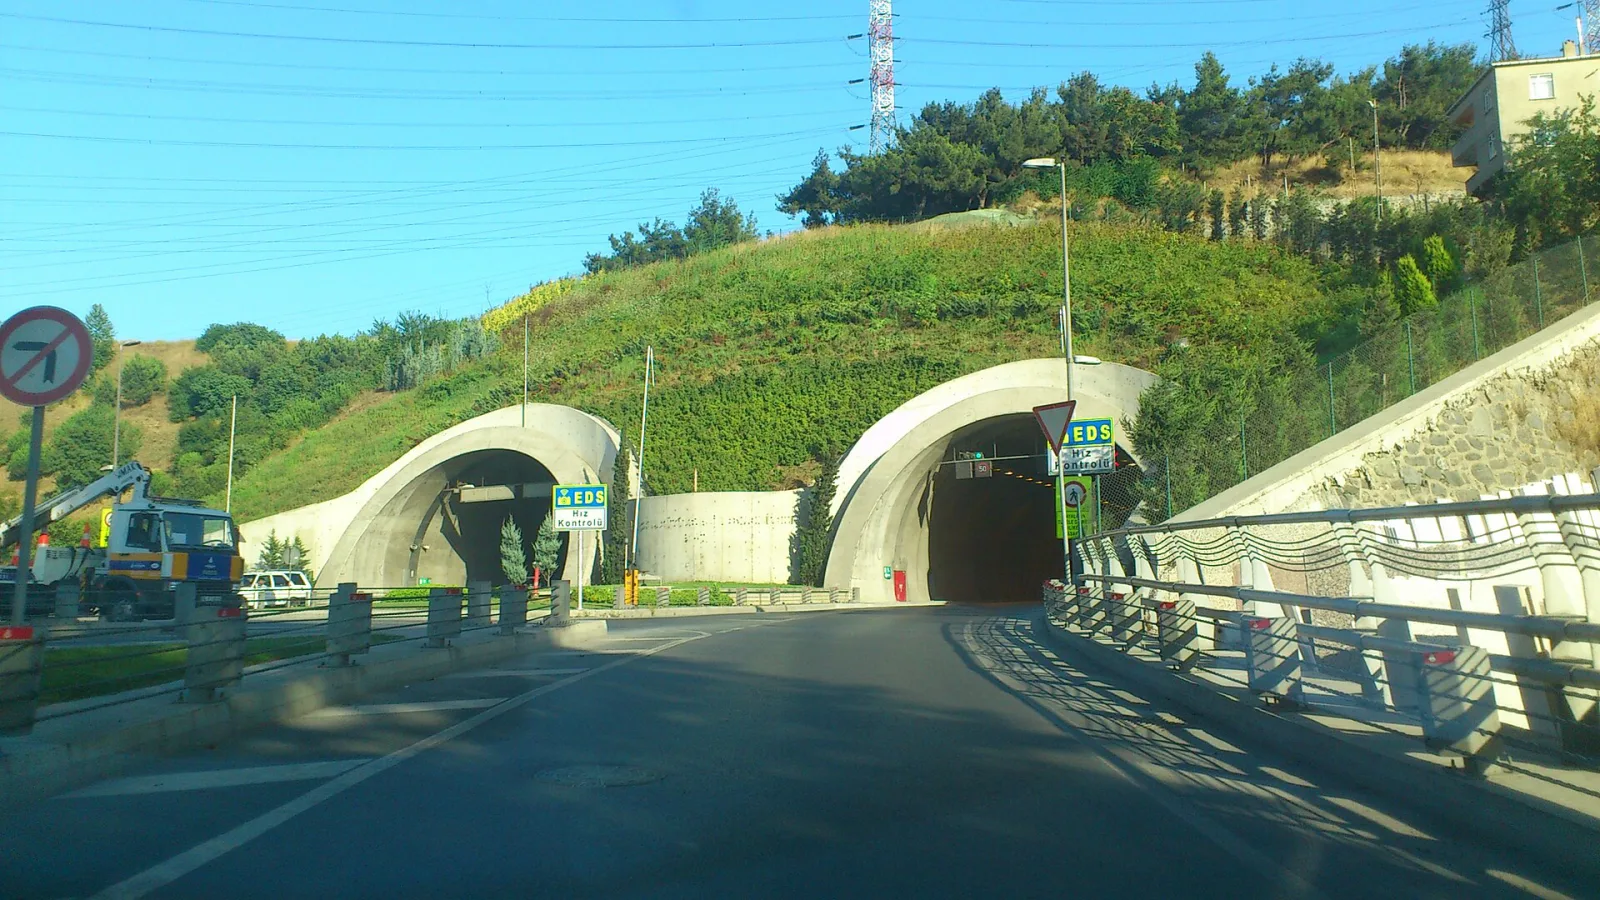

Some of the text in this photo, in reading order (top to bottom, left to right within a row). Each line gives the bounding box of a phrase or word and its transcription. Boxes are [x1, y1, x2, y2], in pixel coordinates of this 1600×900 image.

[1073, 424, 1111, 442] EDS
[574, 490, 604, 505] EDS
[558, 518, 603, 527] Kontrolü
